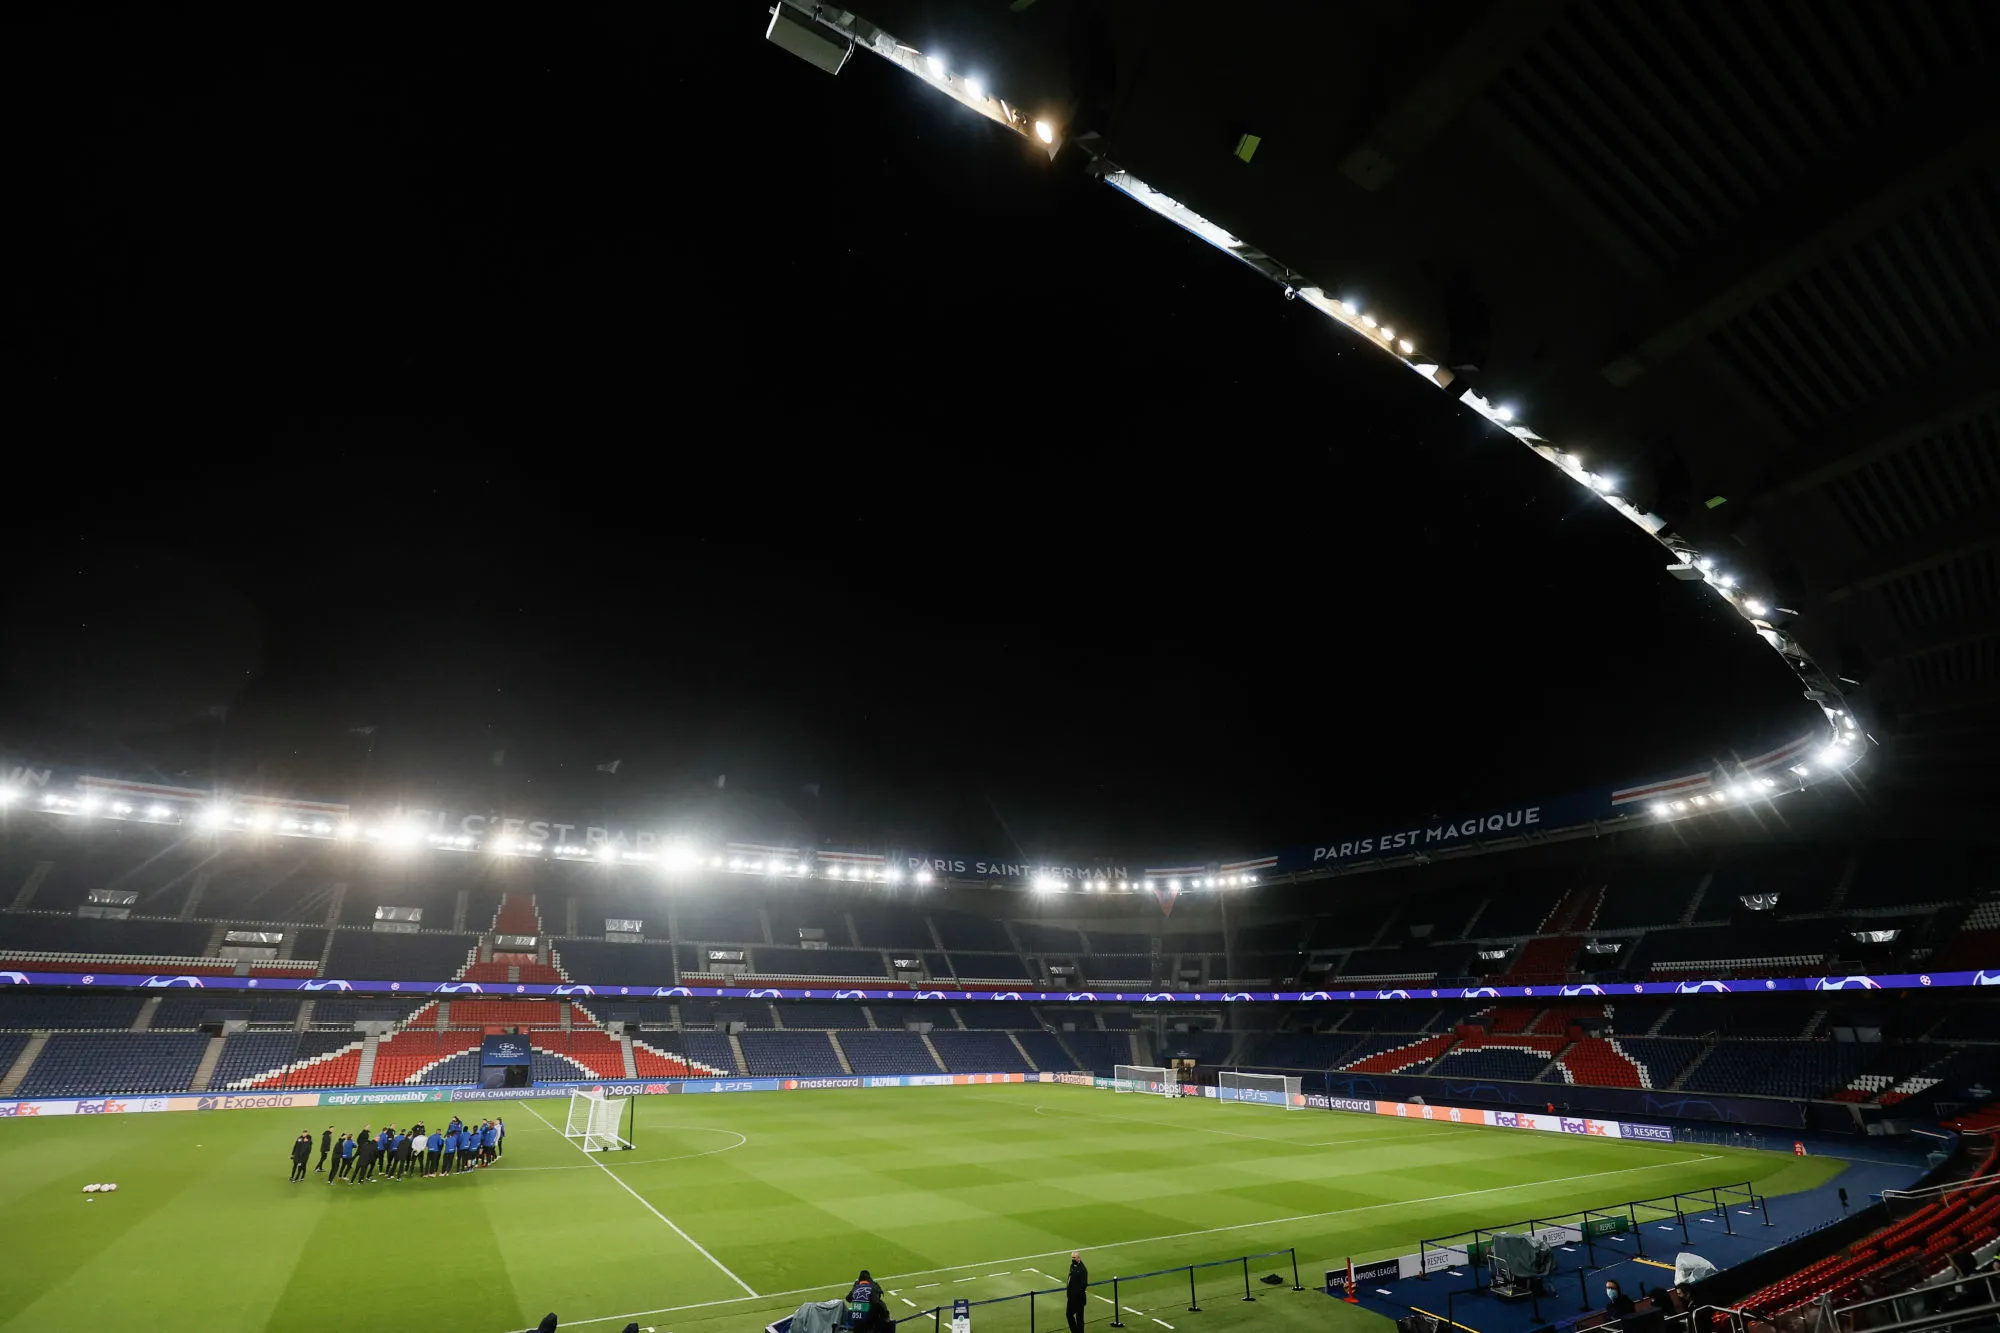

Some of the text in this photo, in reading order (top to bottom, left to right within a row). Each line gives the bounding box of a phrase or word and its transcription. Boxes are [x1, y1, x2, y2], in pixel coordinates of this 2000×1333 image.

[1313, 806, 1541, 862] PARIS EST MAGIQUE
[908, 858, 967, 873] PARIS
[605, 1083, 671, 1097] pepsi MAX
[725, 1082, 753, 1091] PS5
[800, 1078, 859, 1089] mastercard
[328, 1091, 428, 1105] enjoy responsibly
[464, 1088, 567, 1099] UEFA CHAMPIONS LEAGUE
[1245, 1091, 1268, 1101] PS5
[75, 1100, 127, 1114] FedEx
[223, 1095, 293, 1109] Expedia
[1308, 1095, 1371, 1112] mastercard
[0, 1102, 41, 1117] edEx
[1494, 1111, 1536, 1129] FedEx
[1559, 1117, 1607, 1136] FedEx
[1634, 1127, 1671, 1139] RESPECT
[1427, 1254, 1449, 1266] RESPECT
[1328, 1265, 1398, 1287] UEFA CMPIONS LEAGUE
